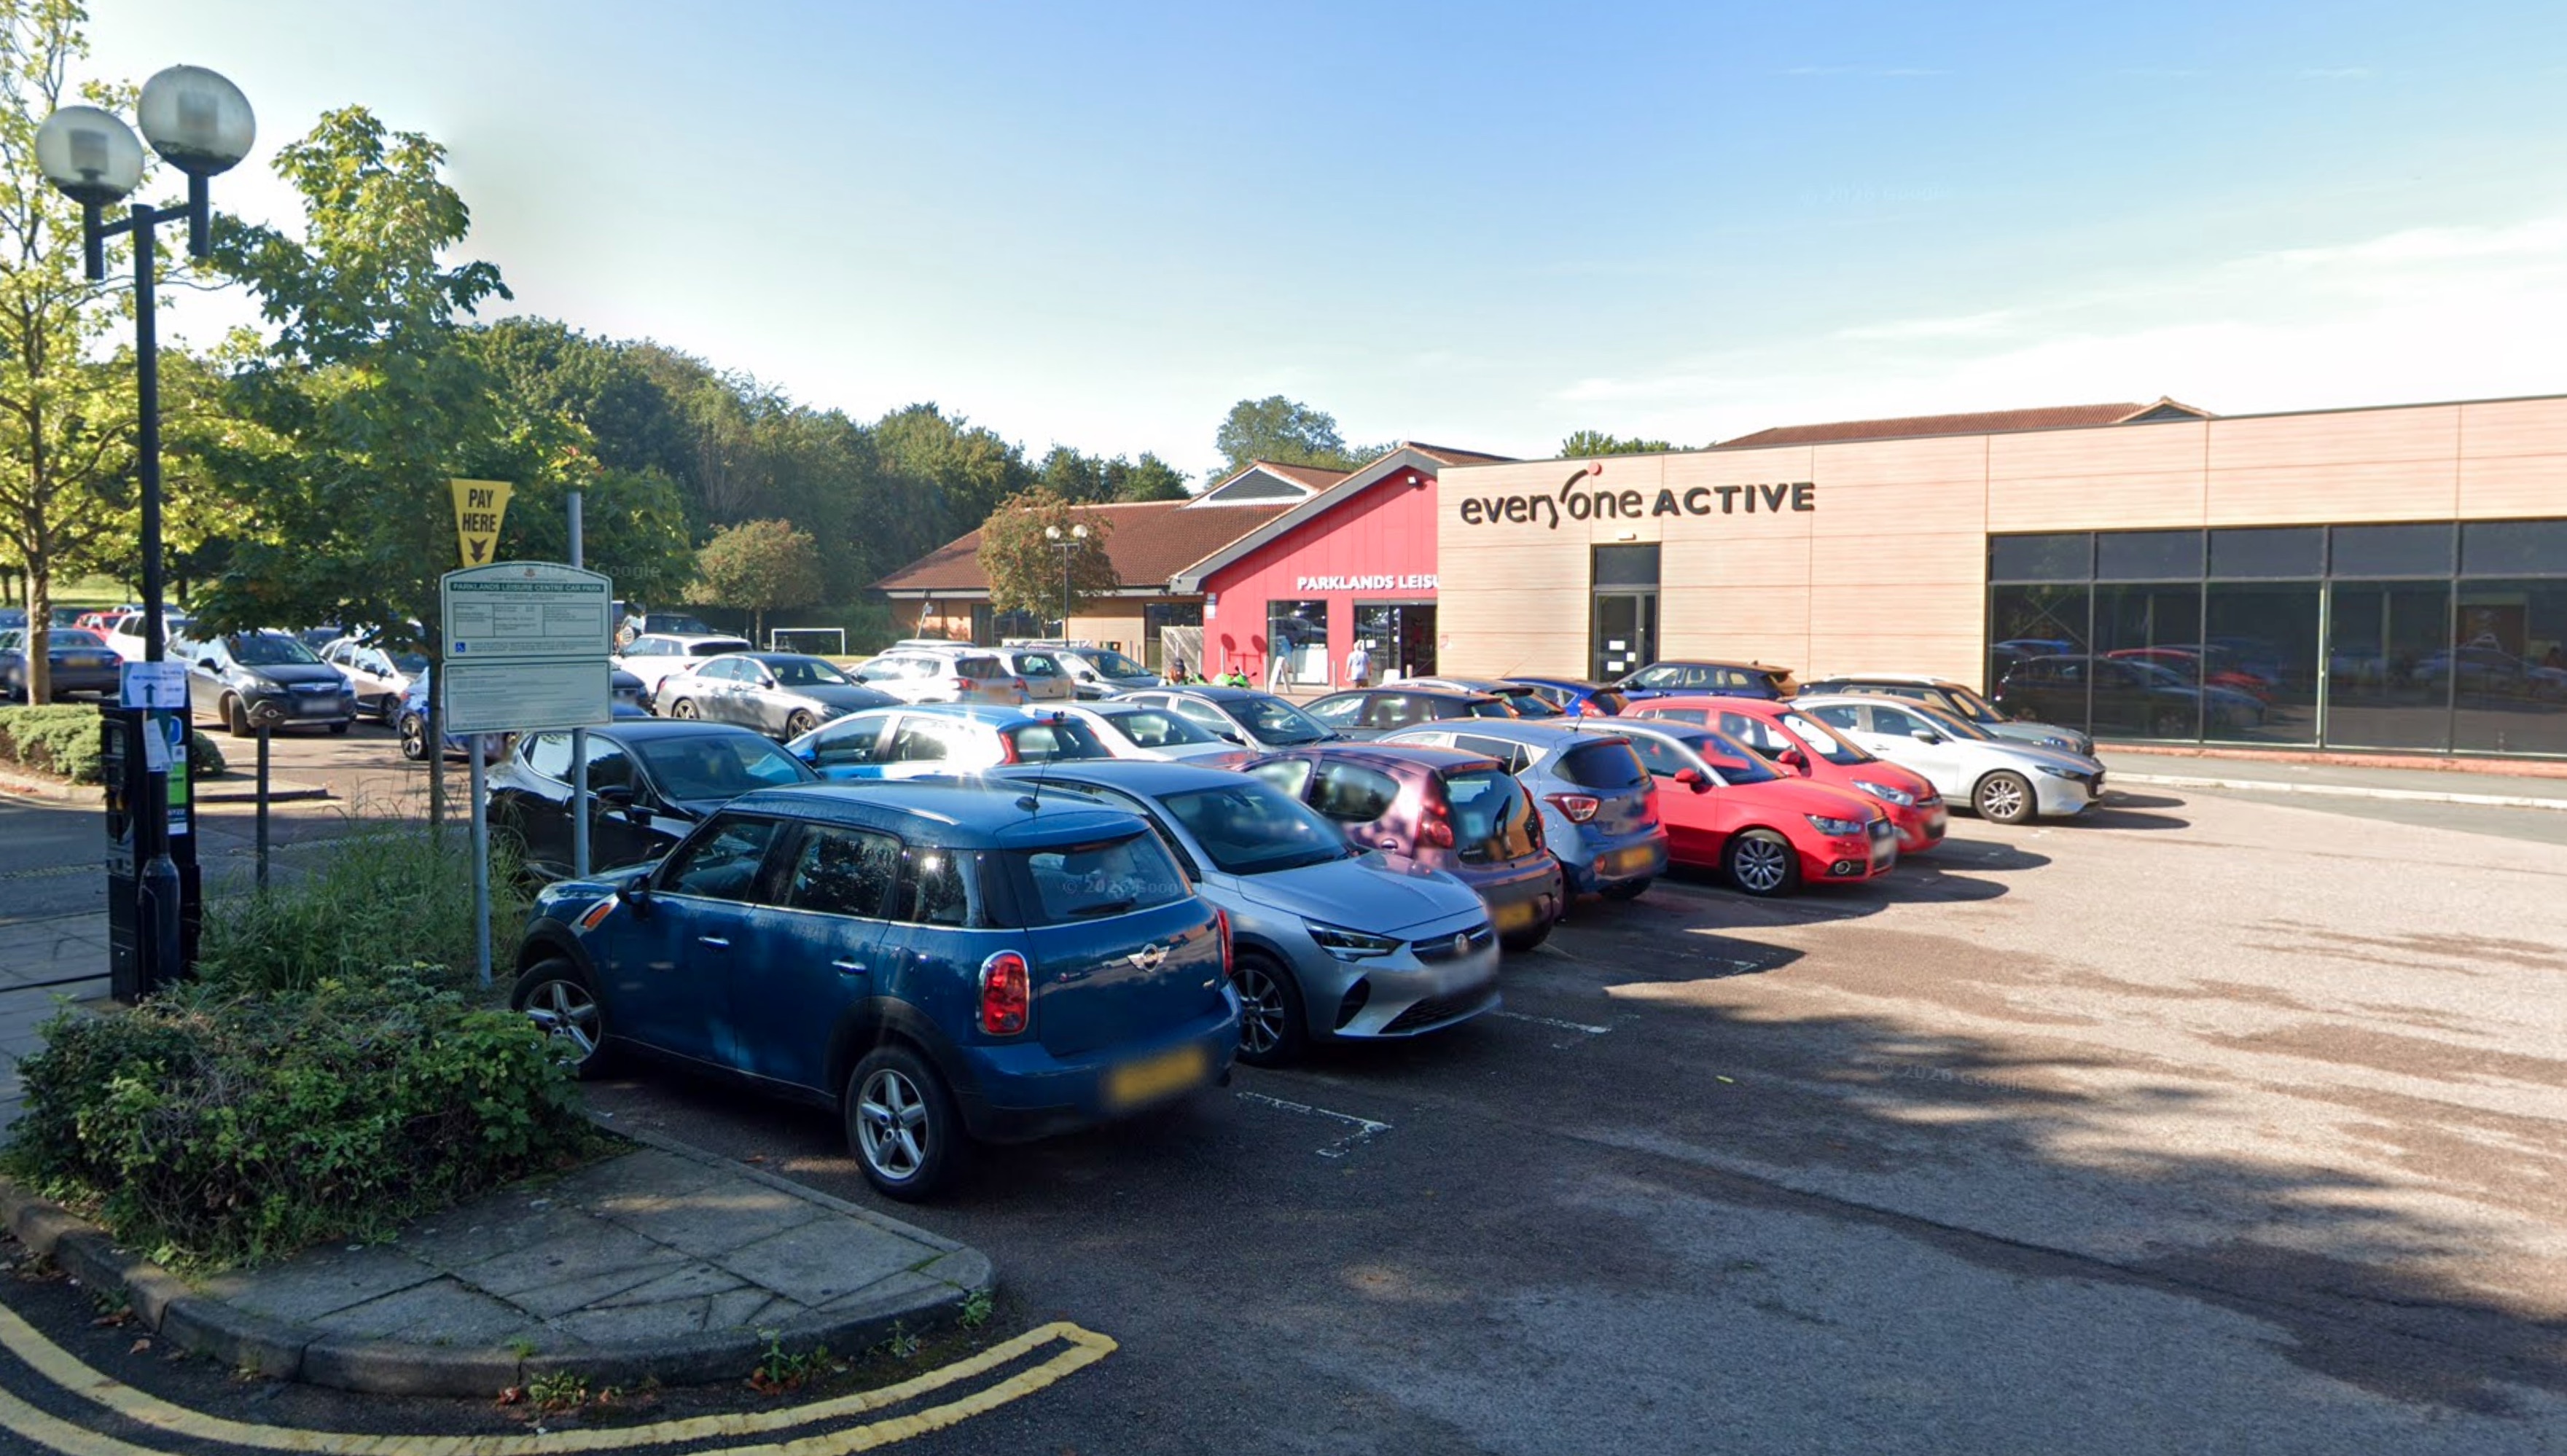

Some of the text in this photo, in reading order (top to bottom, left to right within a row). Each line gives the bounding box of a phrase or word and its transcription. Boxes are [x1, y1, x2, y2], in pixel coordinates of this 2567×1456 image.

[469, 488, 494, 508] PAY
[1652, 482, 1816, 517] ACTIVE
[462, 512, 497, 532] HERE
[1297, 575, 1395, 590] PARKLANDS
